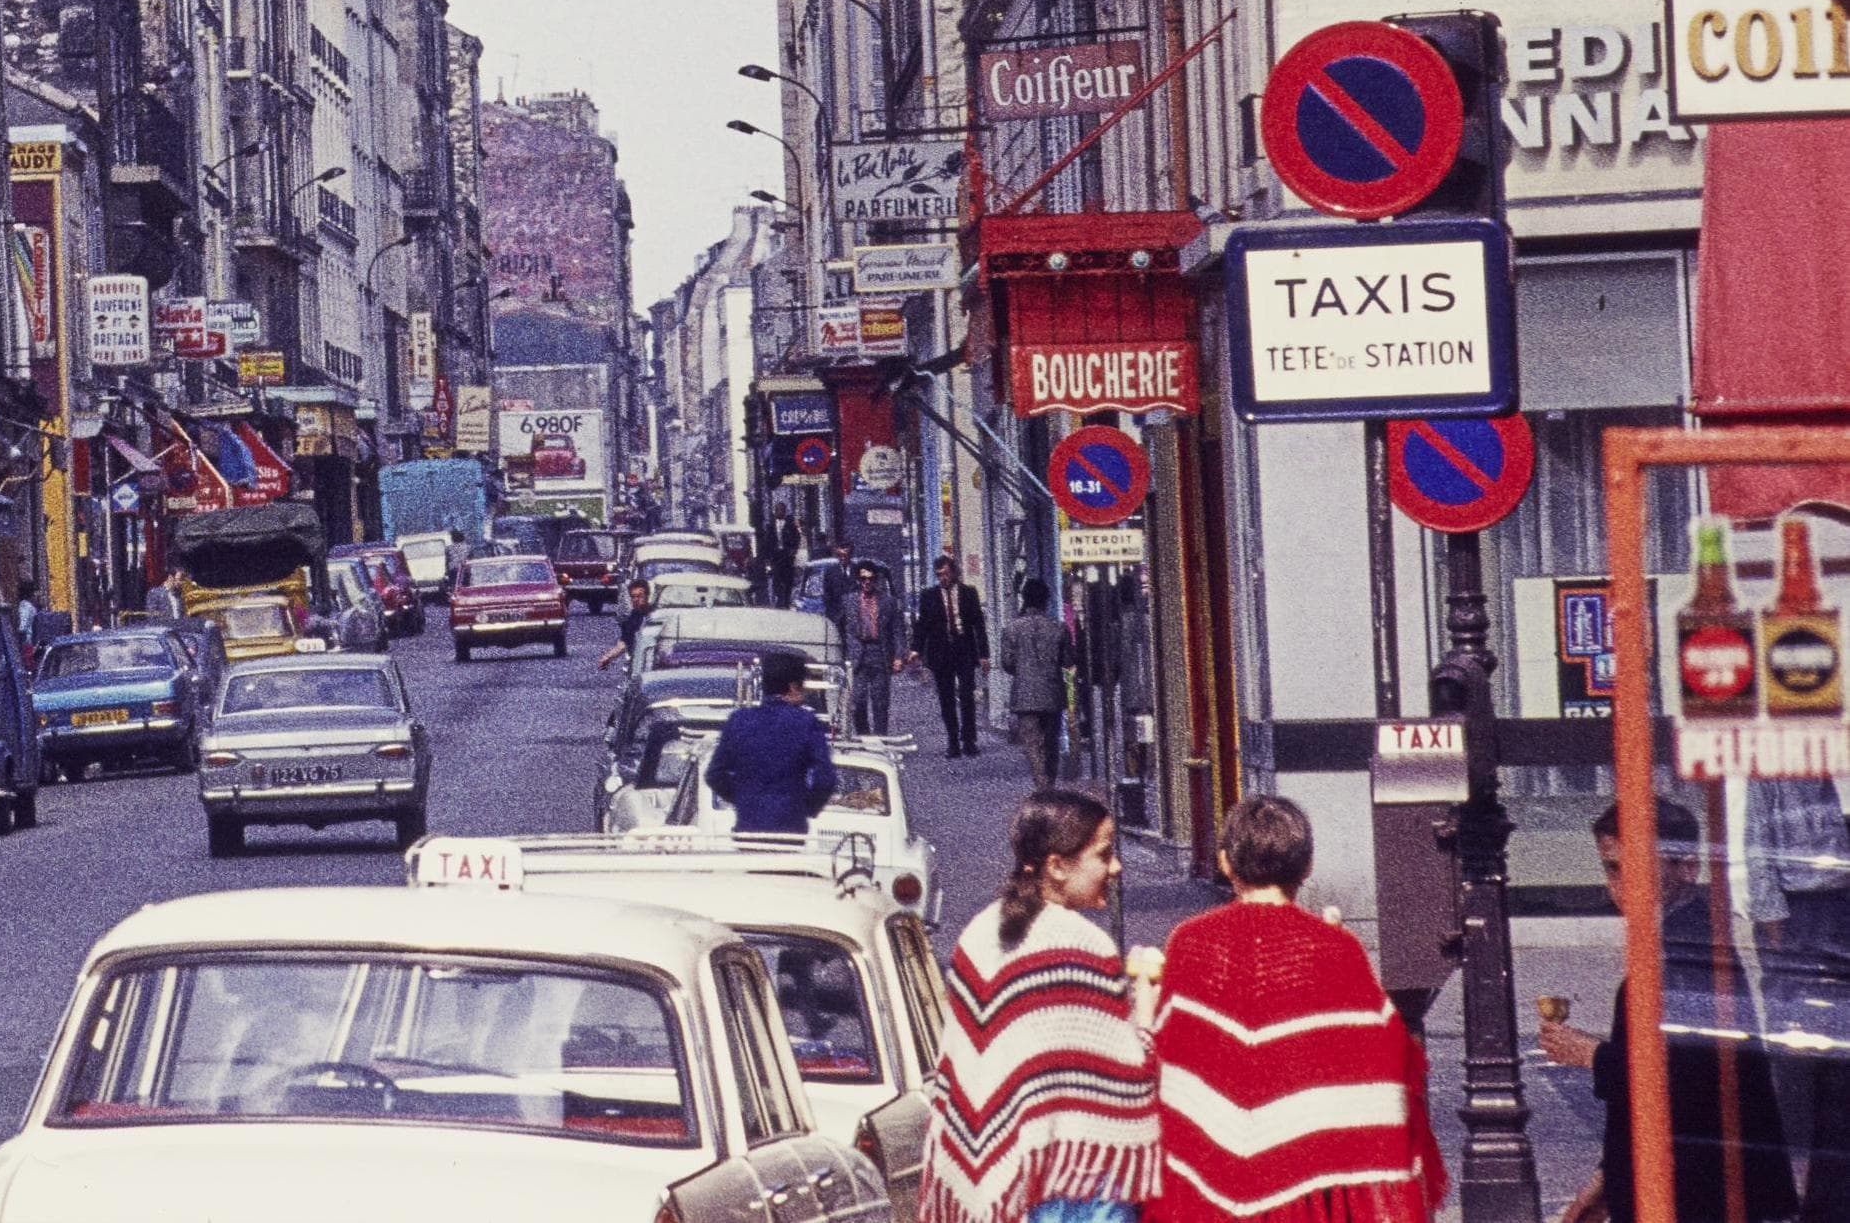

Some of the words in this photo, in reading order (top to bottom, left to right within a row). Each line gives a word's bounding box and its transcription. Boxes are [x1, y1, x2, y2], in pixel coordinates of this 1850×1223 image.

[989, 54, 1137, 109] Coiffeur
[33, 232, 47, 343] PRESSING
[1275, 272, 1456, 318] TAXIS
[93, 299, 143, 312] AUVERGNE
[93, 333, 143, 346] BRETAGNE
[1365, 340, 1474, 369] STATION
[1030, 349, 1181, 402] BOUCHERIE
[1069, 480, 1101, 494] 16-31
[1069, 535, 1133, 545] INTERDIT
[1392, 725, 1453, 750] TAXI
[439, 853, 508, 881] TAXI
